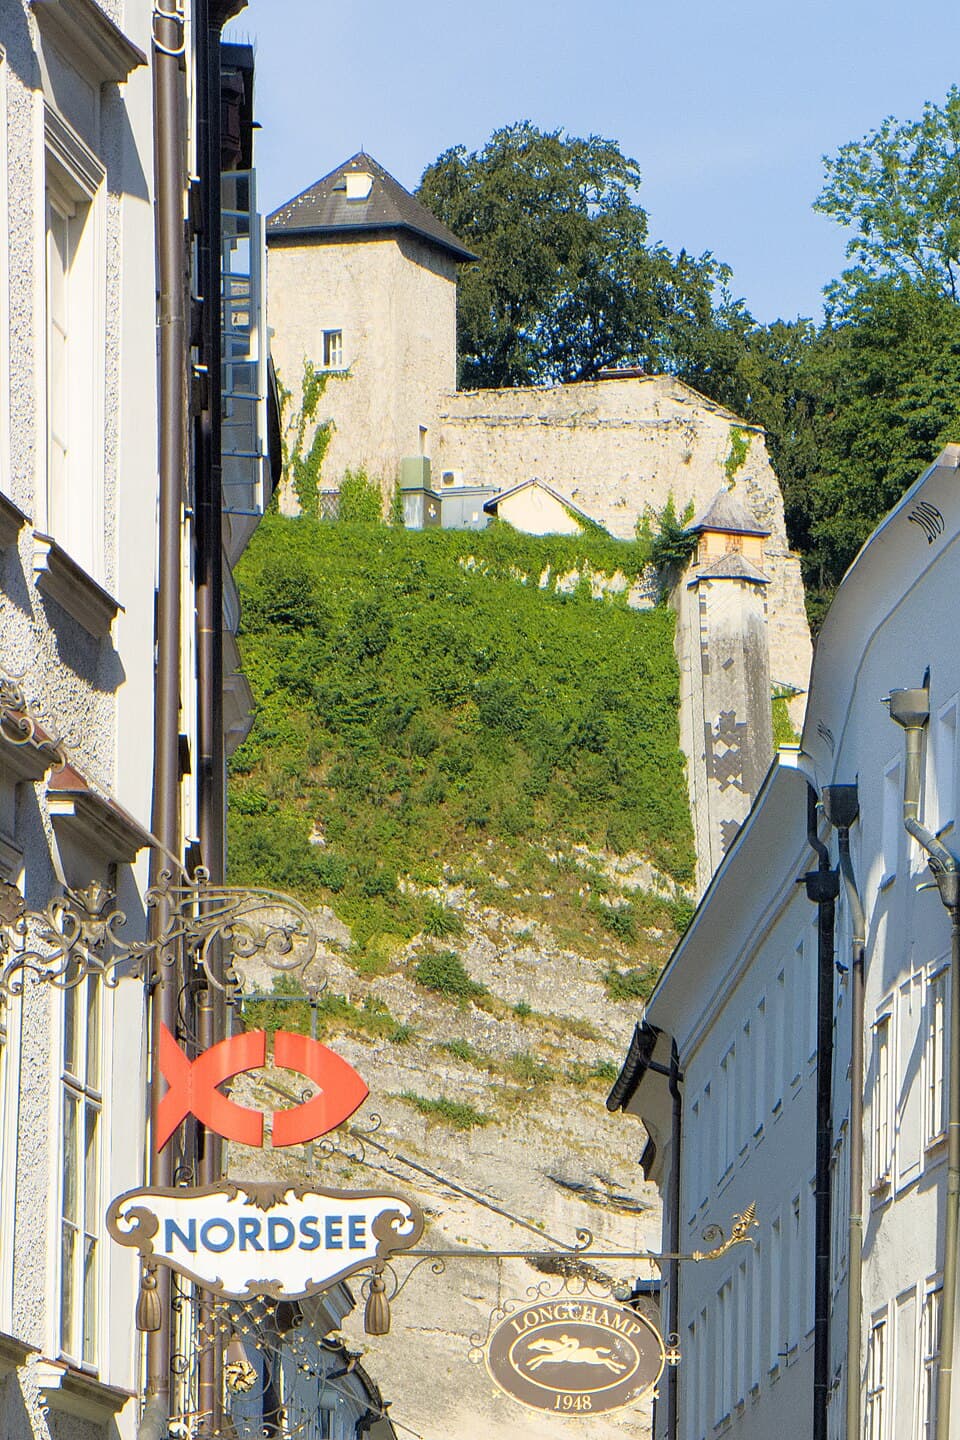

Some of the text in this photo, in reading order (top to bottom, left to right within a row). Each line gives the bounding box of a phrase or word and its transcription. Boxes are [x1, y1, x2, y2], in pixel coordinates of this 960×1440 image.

[165, 1215, 366, 1253] NORDSEE
[511, 1303, 641, 1337] LONGCHAMP
[554, 1395, 592, 1410] 1948
